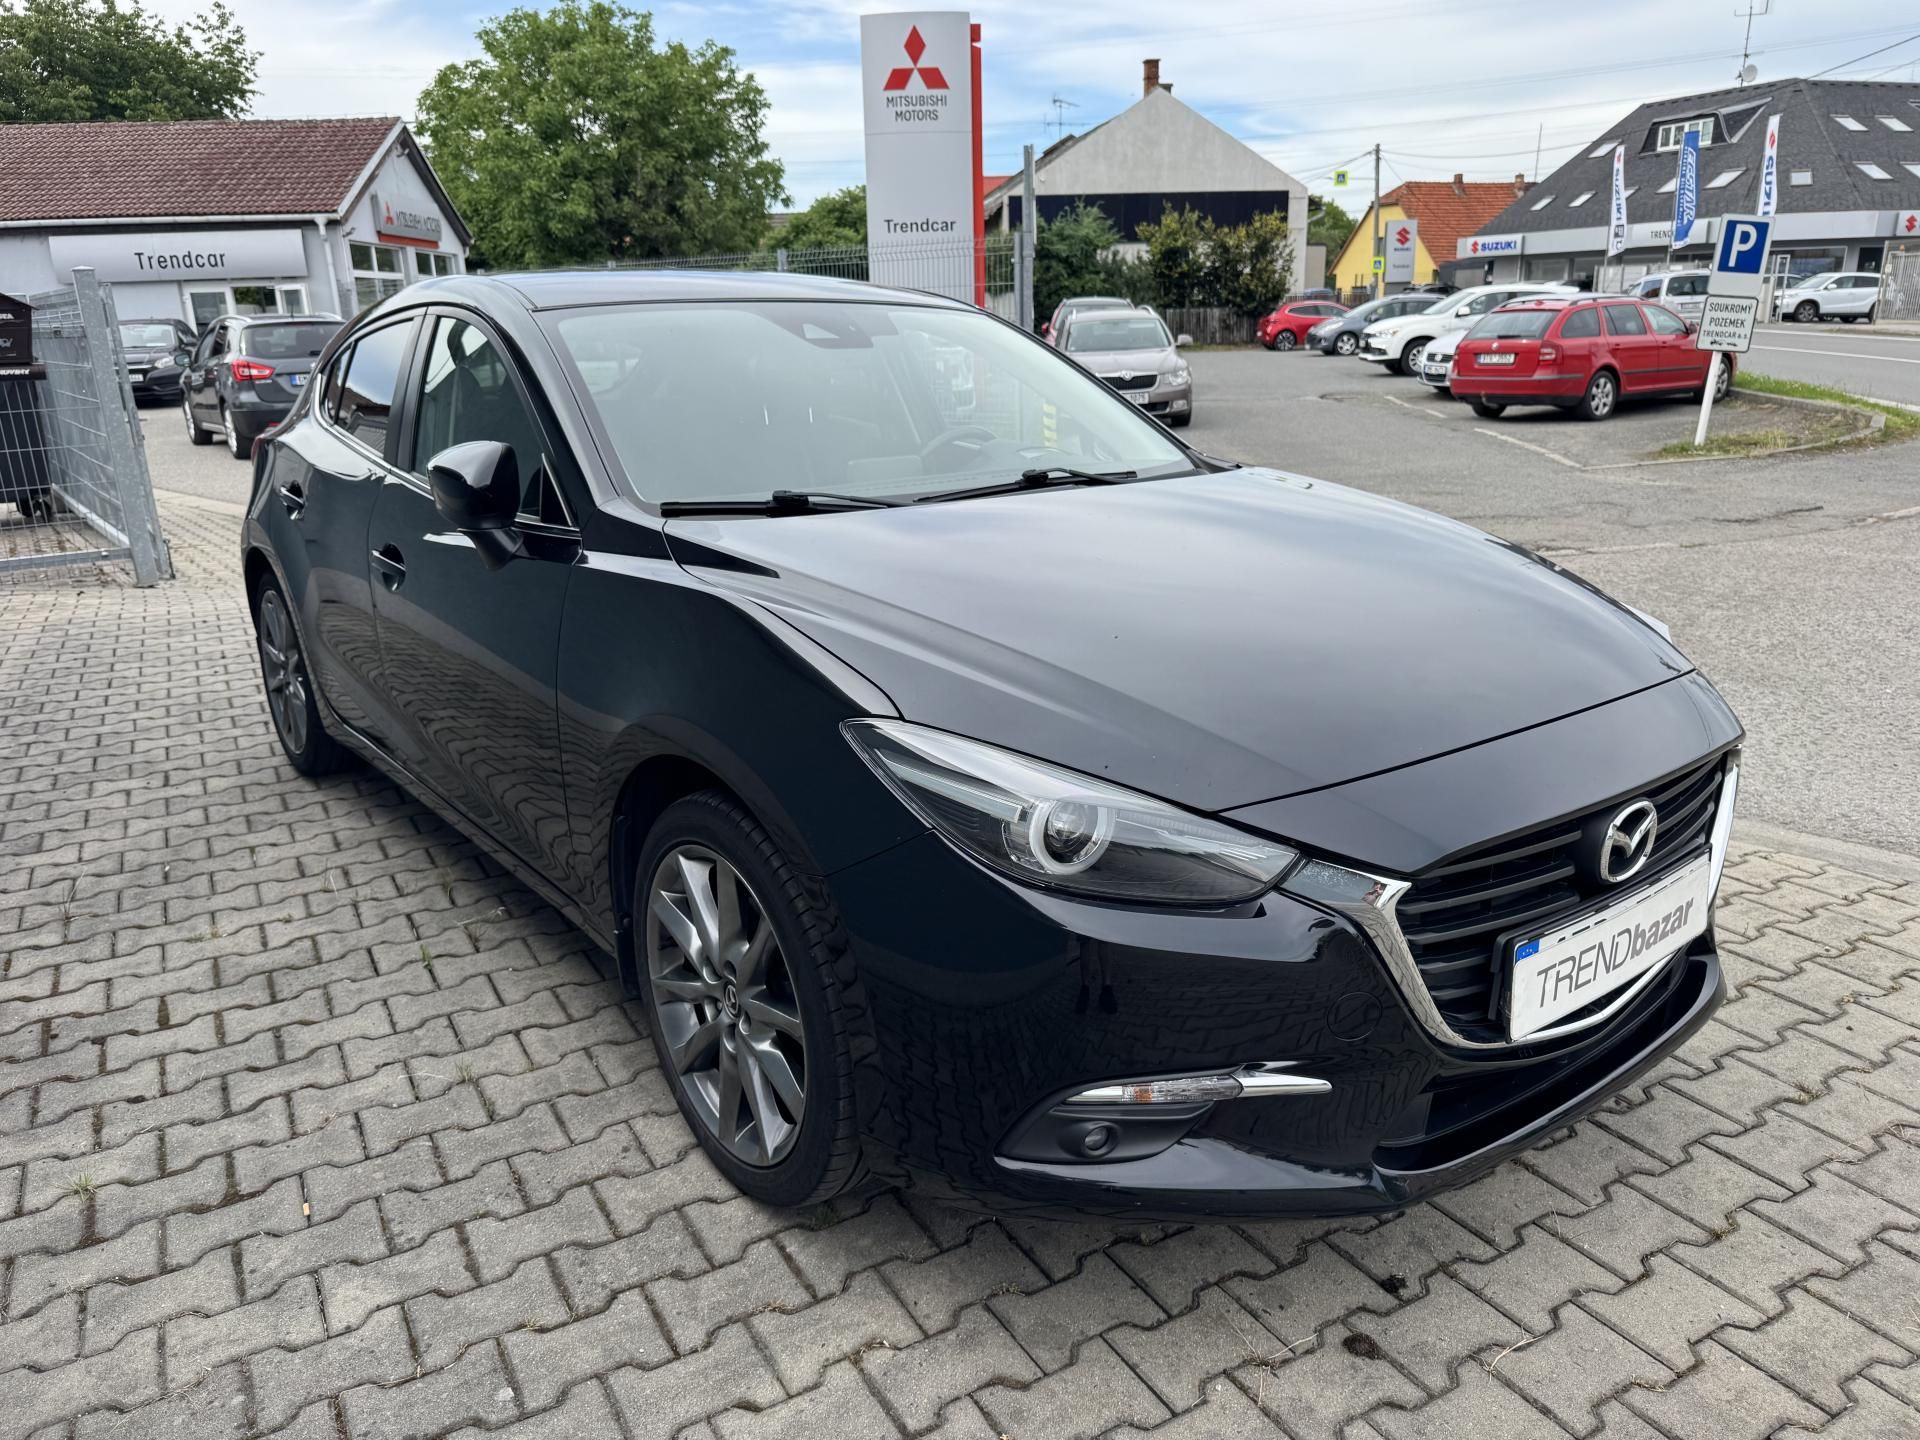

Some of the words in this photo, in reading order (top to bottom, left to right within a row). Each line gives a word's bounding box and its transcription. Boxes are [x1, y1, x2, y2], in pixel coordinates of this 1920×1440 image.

[886, 94, 948, 108] MITSUBISHI
[895, 108, 939, 122] MOTORS
[883, 217, 957, 234] Trendcar
[1481, 240, 1517, 252] SUZUKI
[1728, 223, 1757, 267] P
[133, 250, 225, 270] Trendcar
[1709, 316, 1746, 329] POZEMEK
